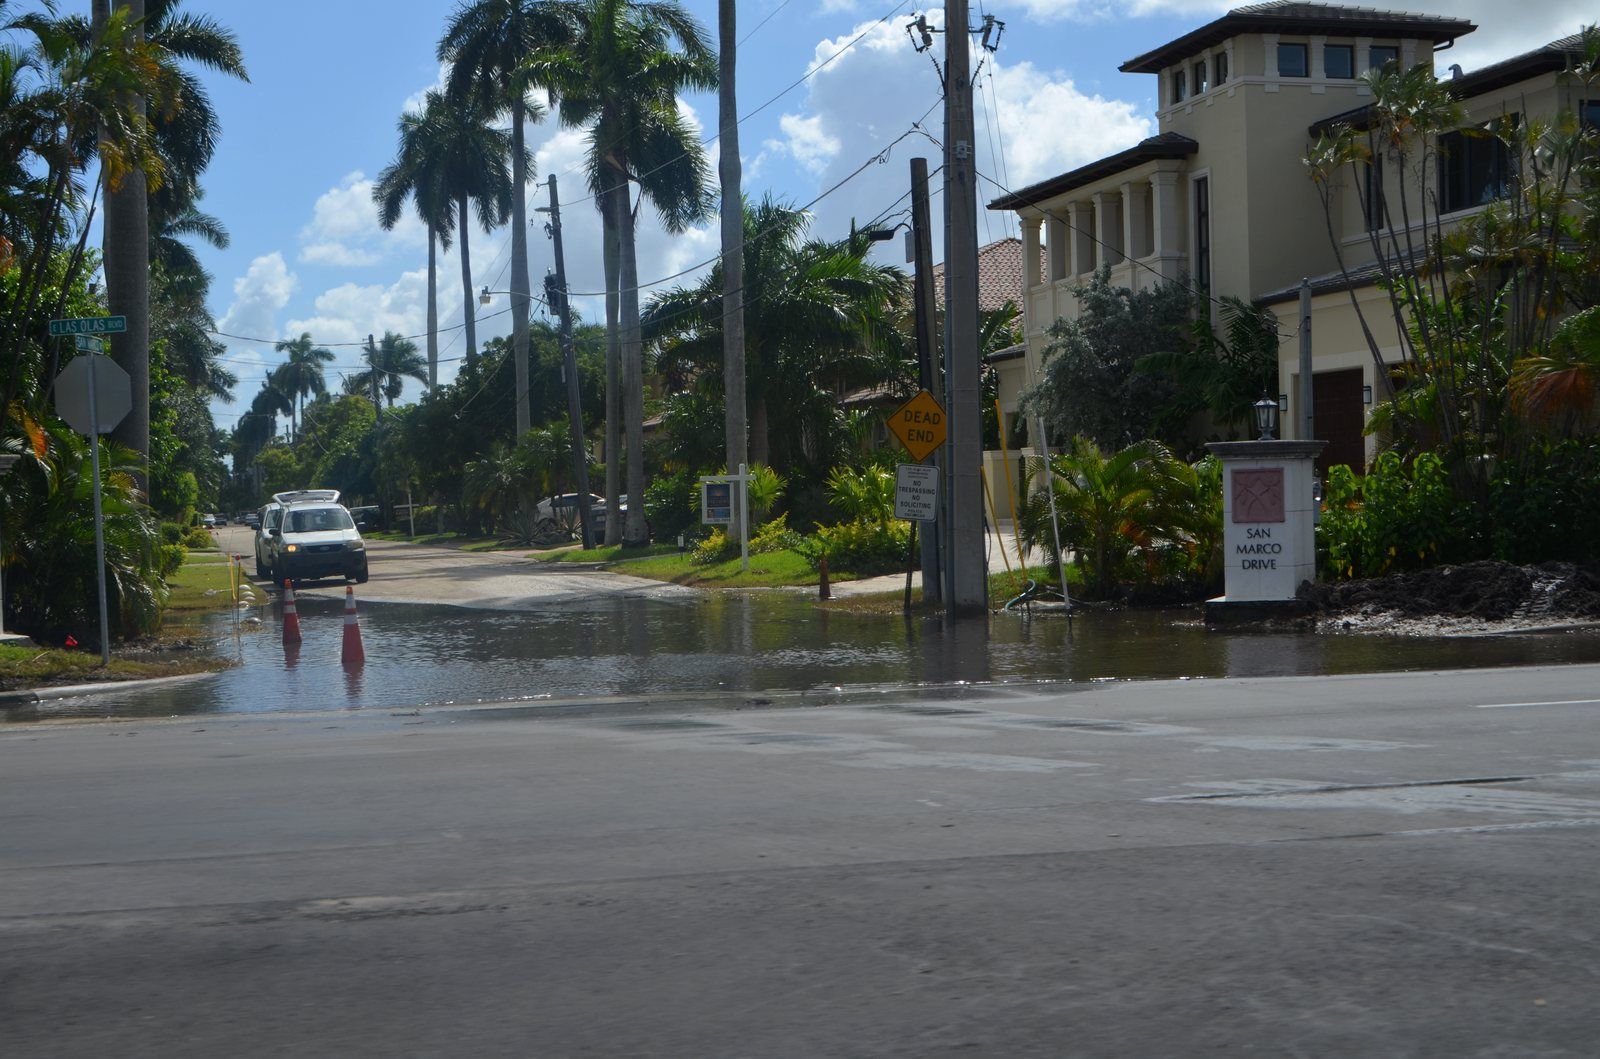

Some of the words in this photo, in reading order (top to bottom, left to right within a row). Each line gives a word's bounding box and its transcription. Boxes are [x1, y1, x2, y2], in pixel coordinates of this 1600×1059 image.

[52, 324, 57, 332] E
[59, 321, 77, 333] LAS
[80, 319, 105, 332] OLAS
[107, 320, 123, 329] BLVD
[904, 410, 941, 425] DEAD
[907, 429, 935, 443] END
[898, 486, 935, 495] TRESPASSING
[900, 501, 932, 509] SOLICITING
[1247, 528, 1271, 539] SAN
[1236, 543, 1282, 554] MARCO
[1242, 559, 1277, 570] DRIVE
